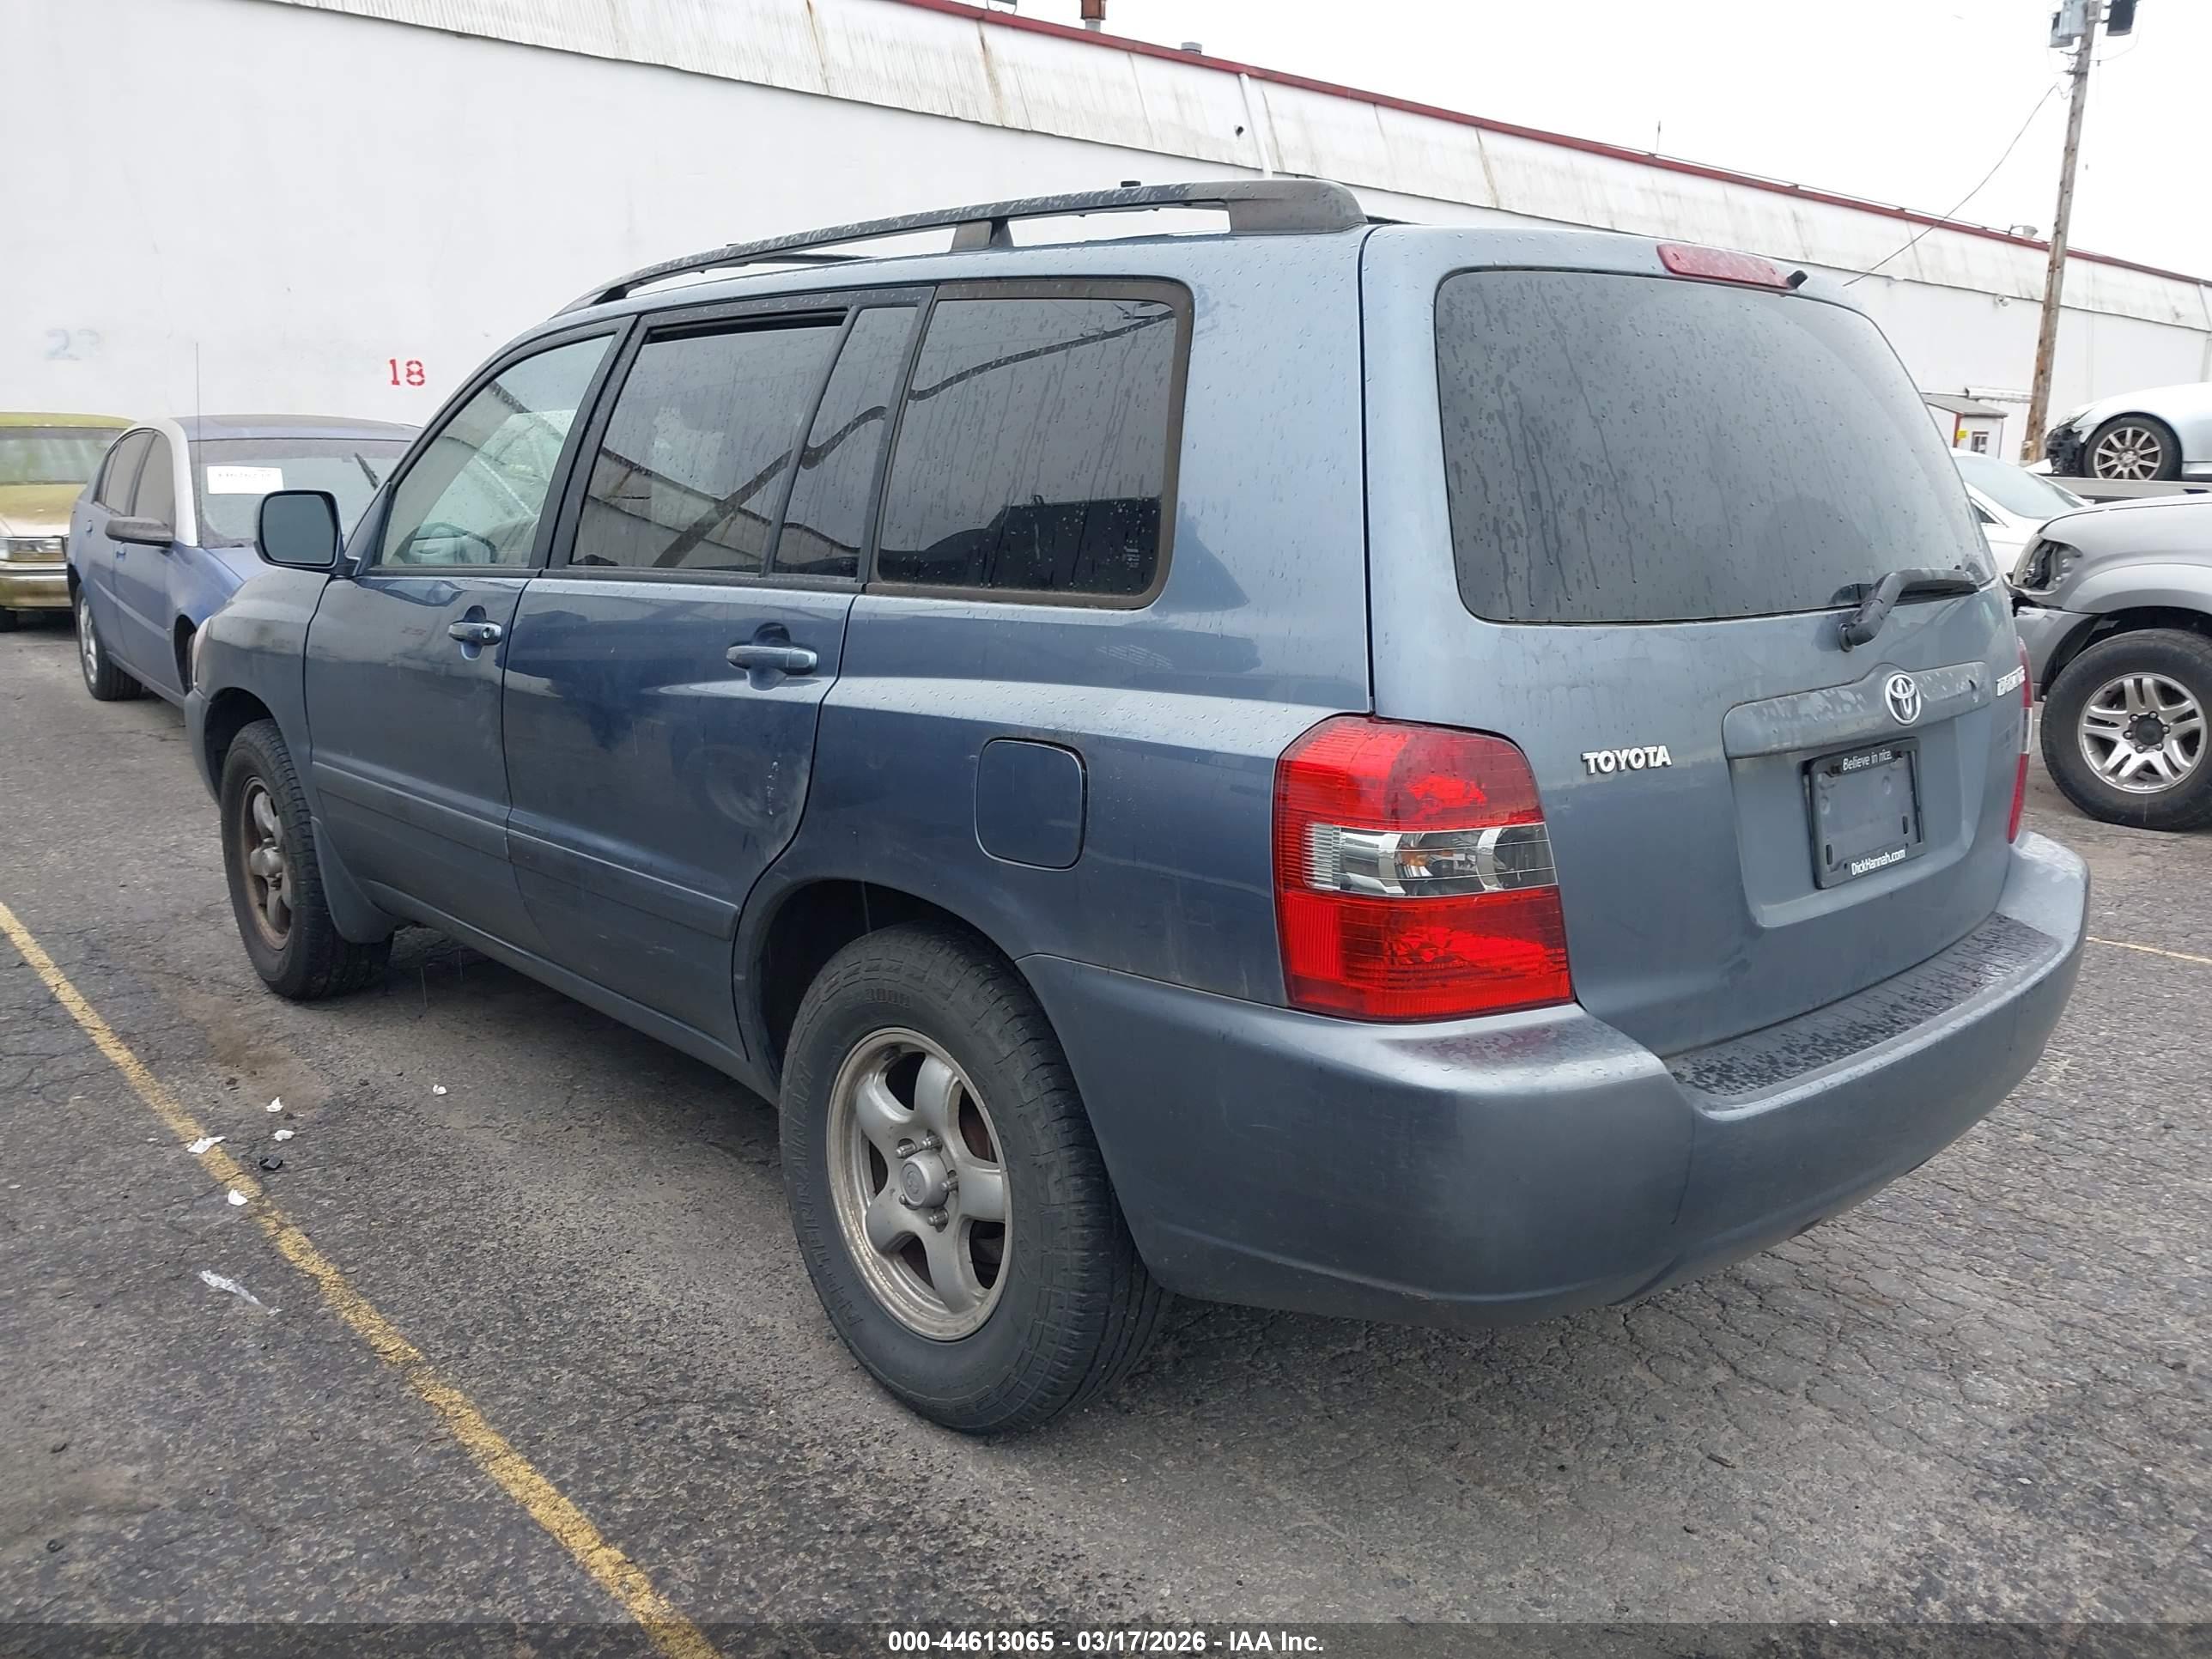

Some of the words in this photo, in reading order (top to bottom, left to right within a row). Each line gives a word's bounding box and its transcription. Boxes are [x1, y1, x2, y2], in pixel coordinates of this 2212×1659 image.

[389, 358, 426, 386] 18
[1582, 745, 1673, 775] TOYOTA
[1843, 756, 1870, 771] Believe
[1871, 751, 1879, 764] in
[1850, 848, 1905, 876] DickHannah.com
